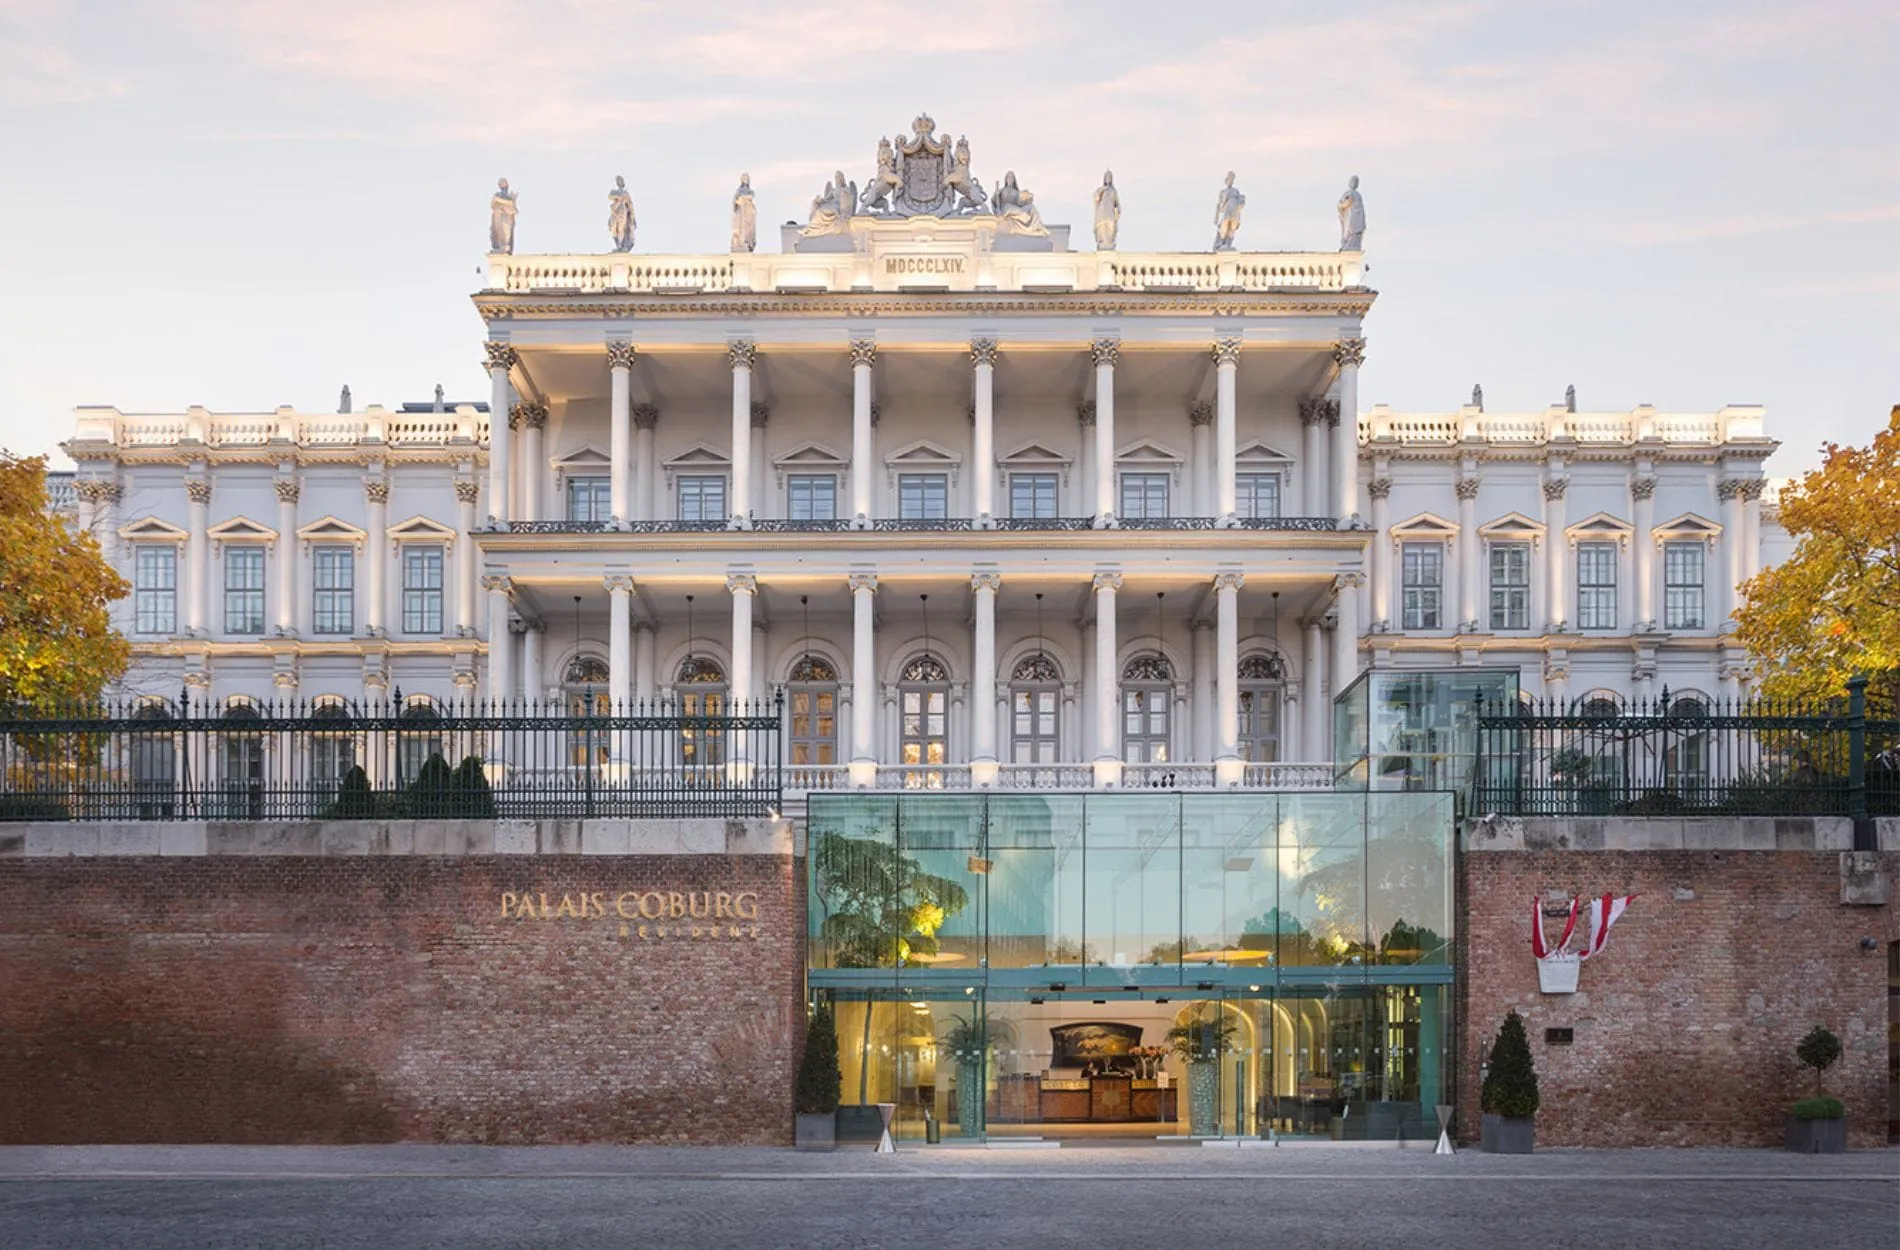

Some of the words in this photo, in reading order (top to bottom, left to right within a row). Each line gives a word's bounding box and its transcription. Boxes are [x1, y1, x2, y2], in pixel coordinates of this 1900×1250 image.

[886, 258, 965, 273] MDCCCLXIV.
[500, 891, 605, 919] PALAIS
[615, 891, 758, 919] COBURG
